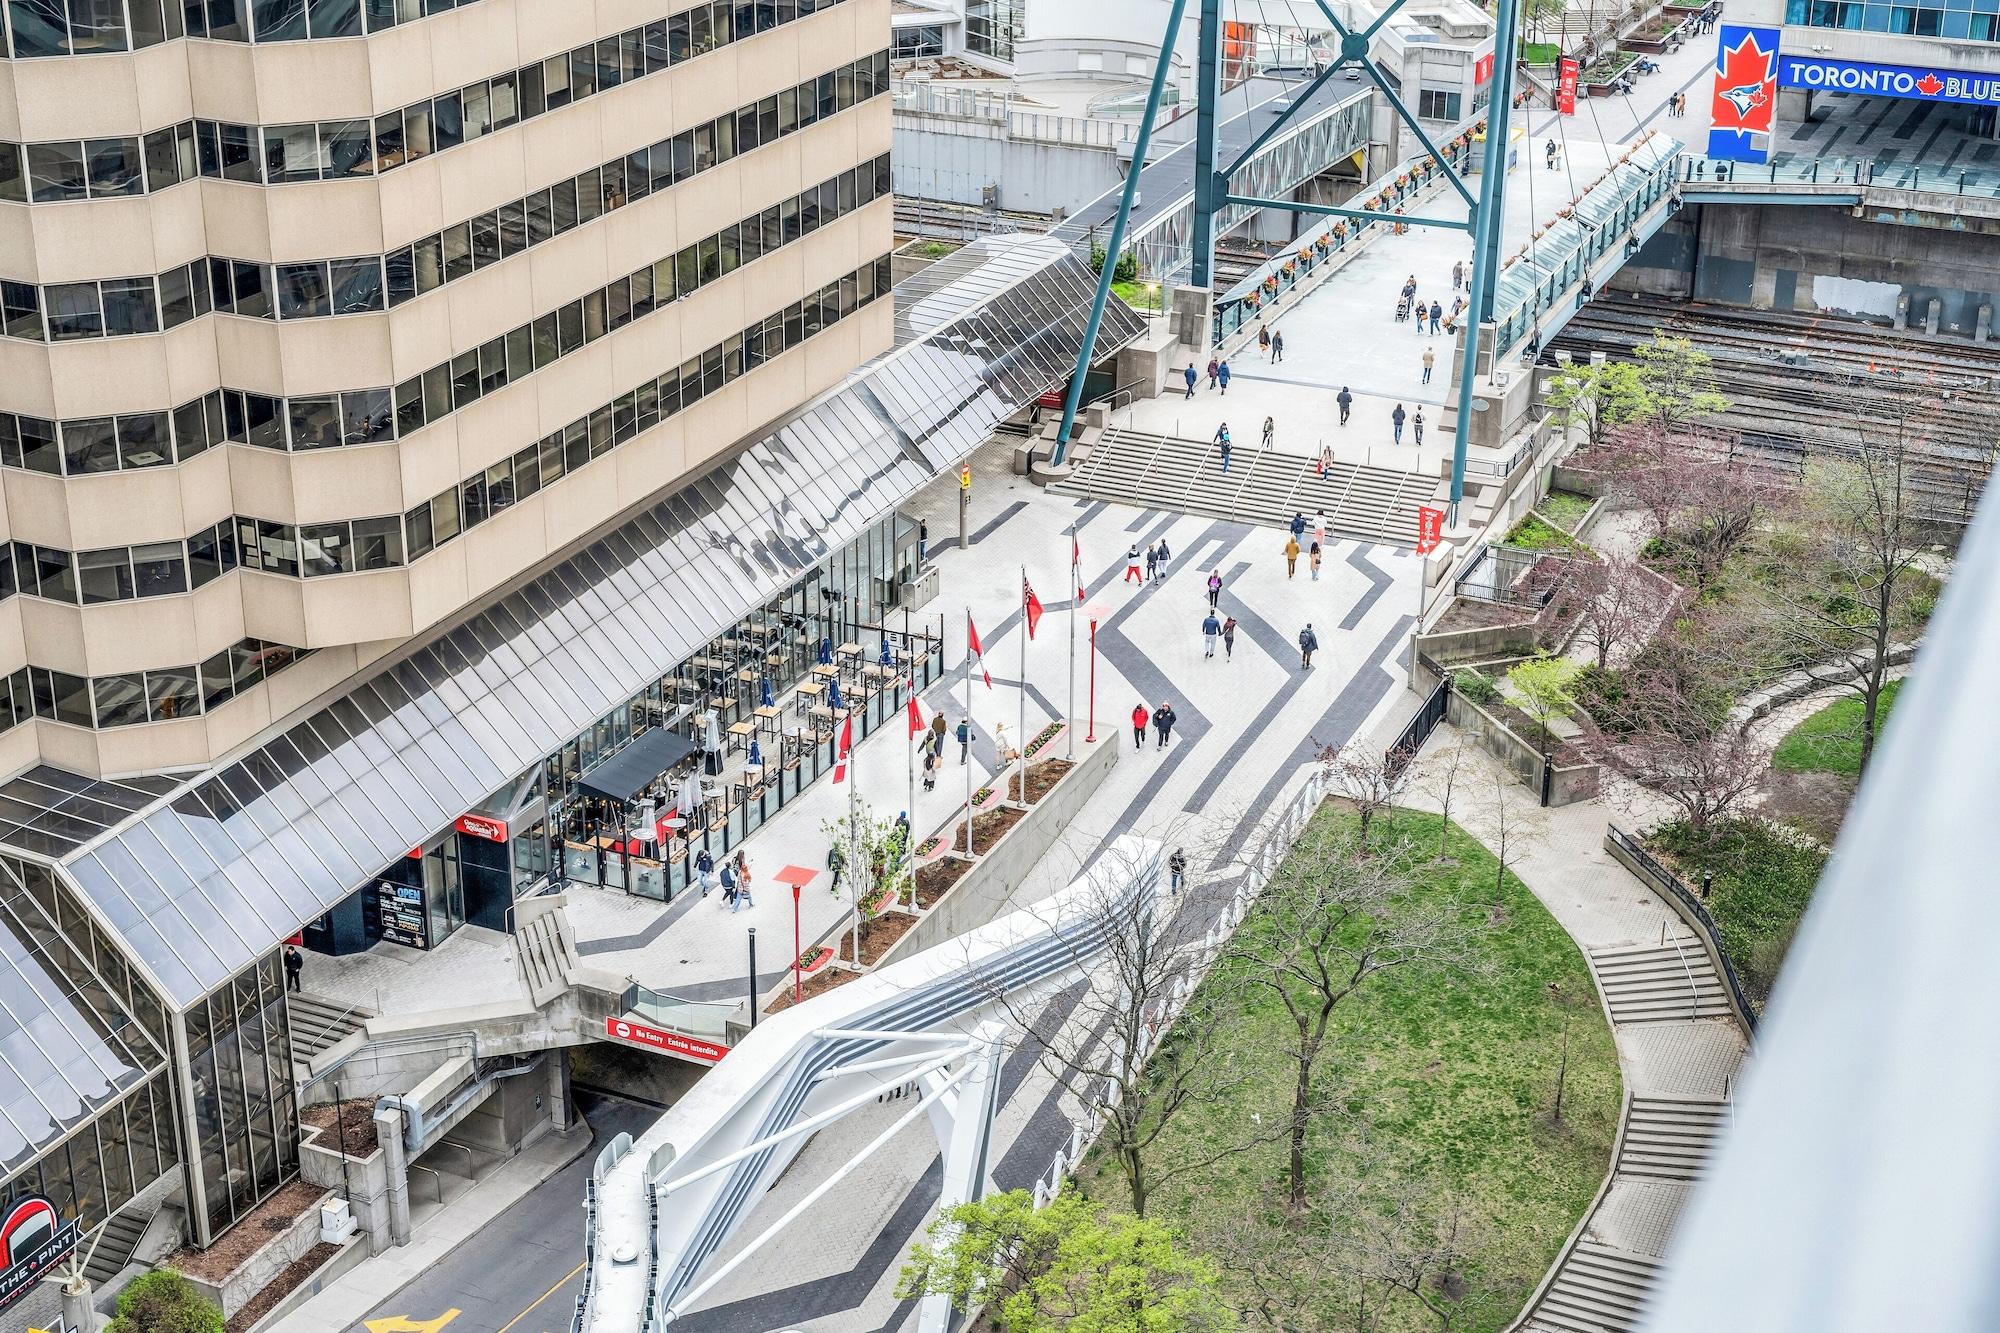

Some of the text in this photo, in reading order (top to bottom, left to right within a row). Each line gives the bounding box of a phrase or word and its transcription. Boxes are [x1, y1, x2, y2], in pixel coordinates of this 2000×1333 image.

[1790, 63, 2000, 101] TORONTO BLUE
[397, 888, 420, 900] OPEN
[636, 1029, 718, 1056] No Entry Entrée interdite
[0, 1232, 71, 1293] THE PINT
